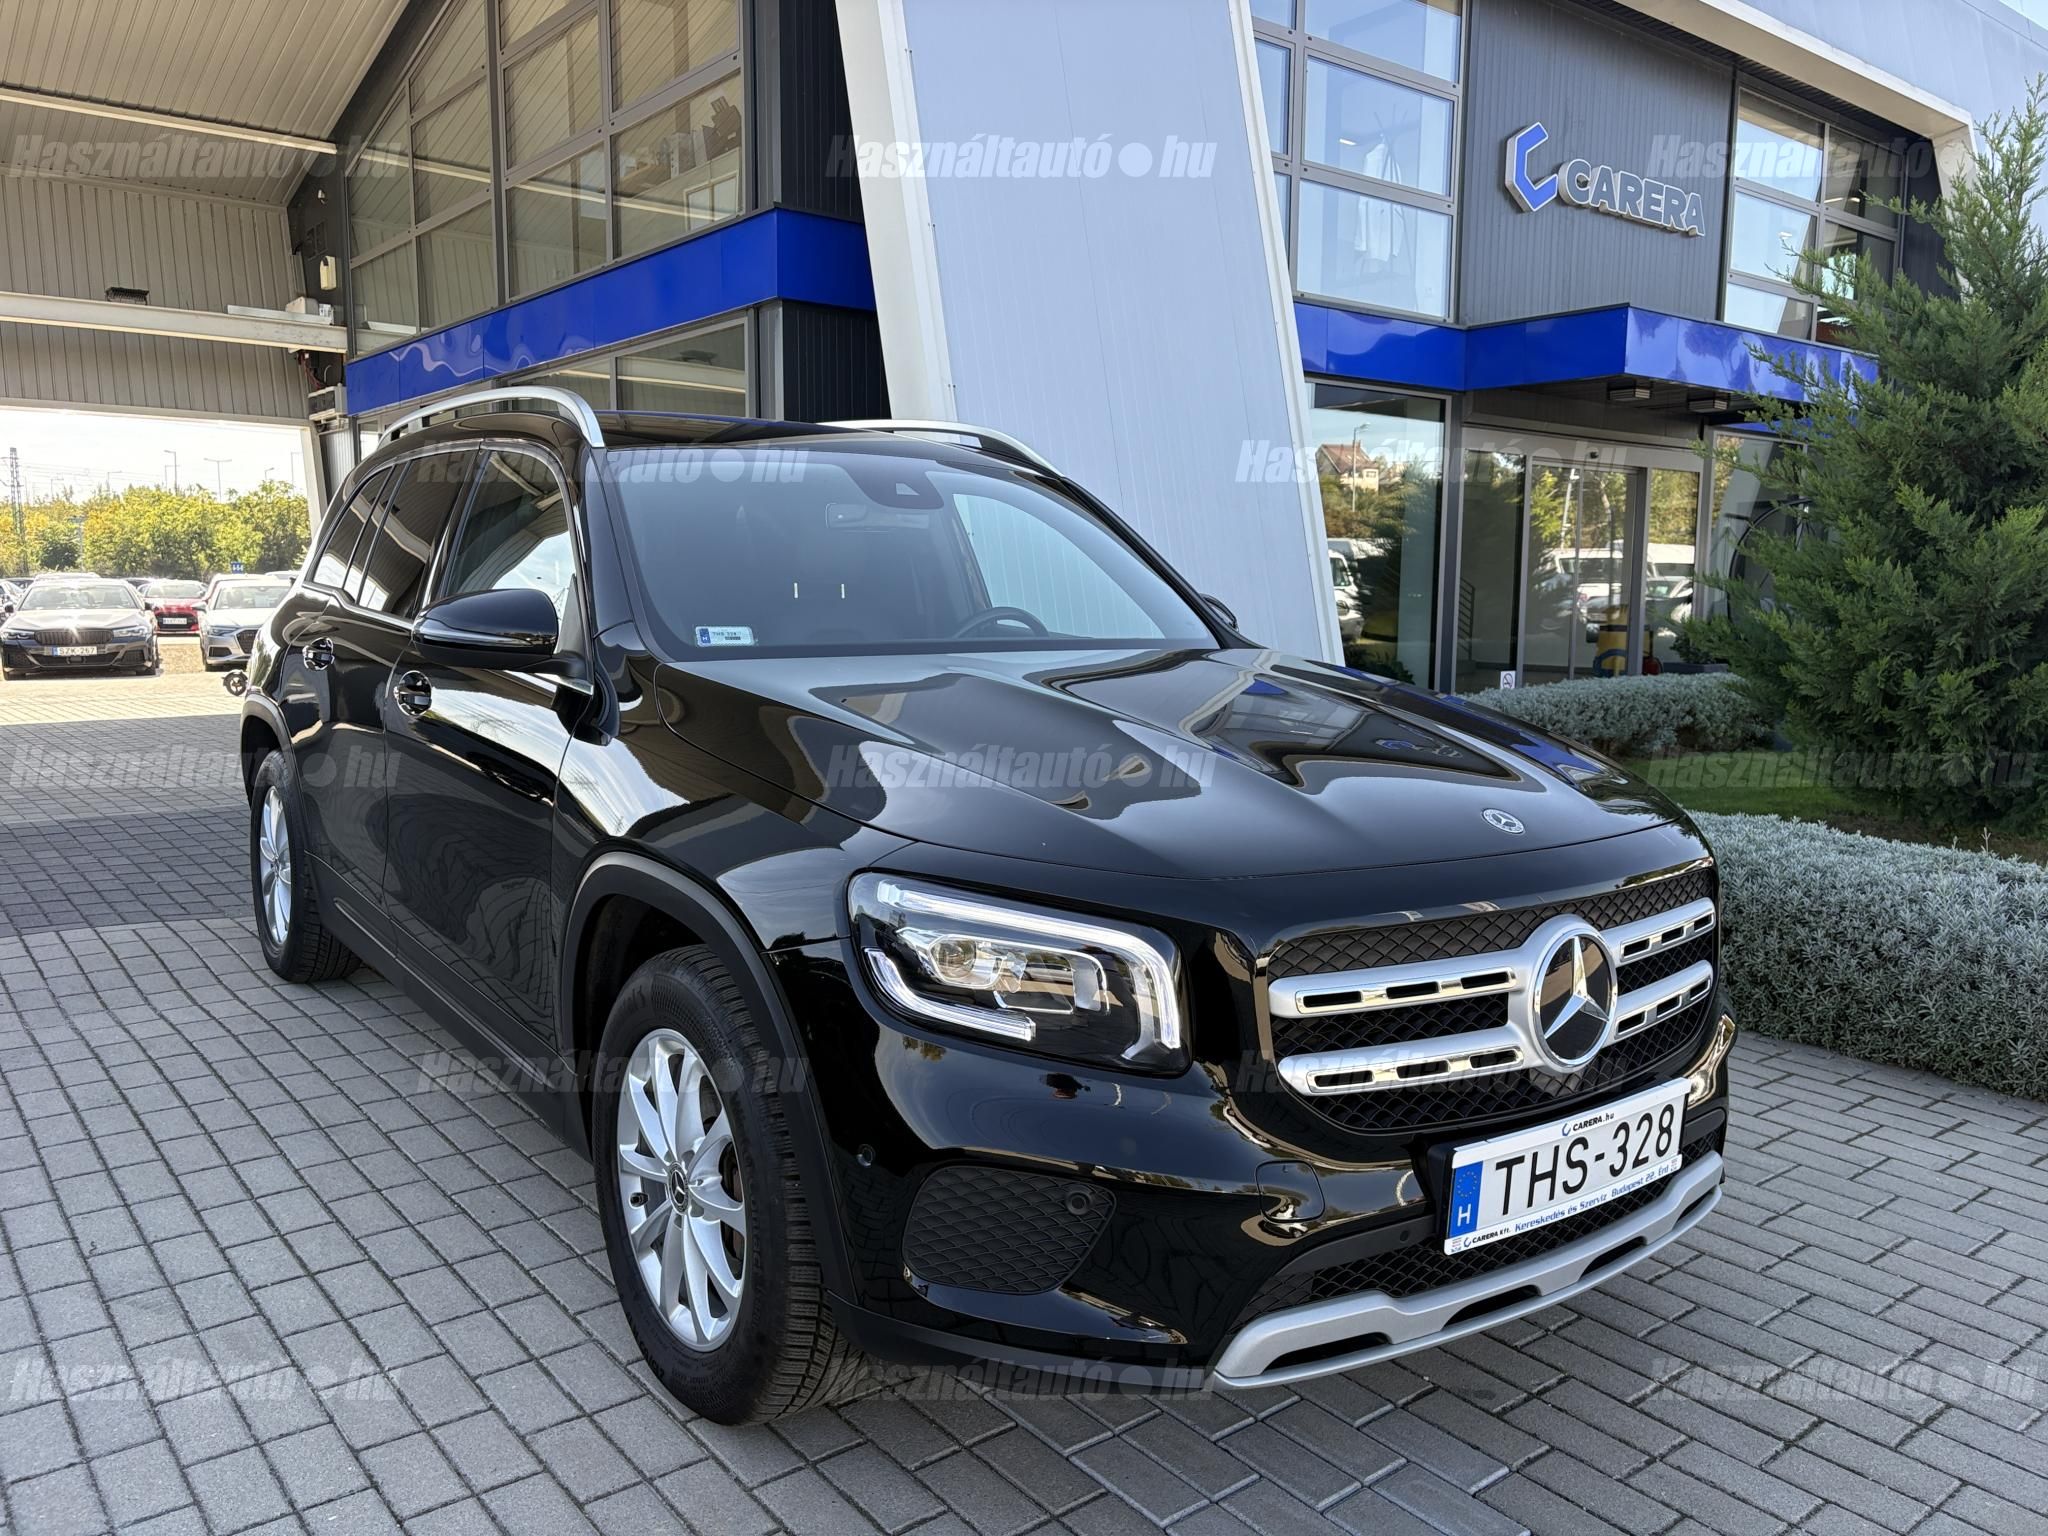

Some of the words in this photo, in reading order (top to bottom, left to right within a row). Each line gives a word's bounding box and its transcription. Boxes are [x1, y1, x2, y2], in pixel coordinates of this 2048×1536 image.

[1559, 158, 1705, 237] CARERA
[1496, 1104, 1674, 1216] THS-328
[1457, 1204, 1471, 1227] H
[1472, 1231, 1499, 1244] CARERA
[1515, 1210, 1565, 1233] Kereskedés
[1567, 1205, 1577, 1214] és
[1579, 1193, 1607, 1210] Szerviz
[1611, 1177, 1644, 1197] Budapest
